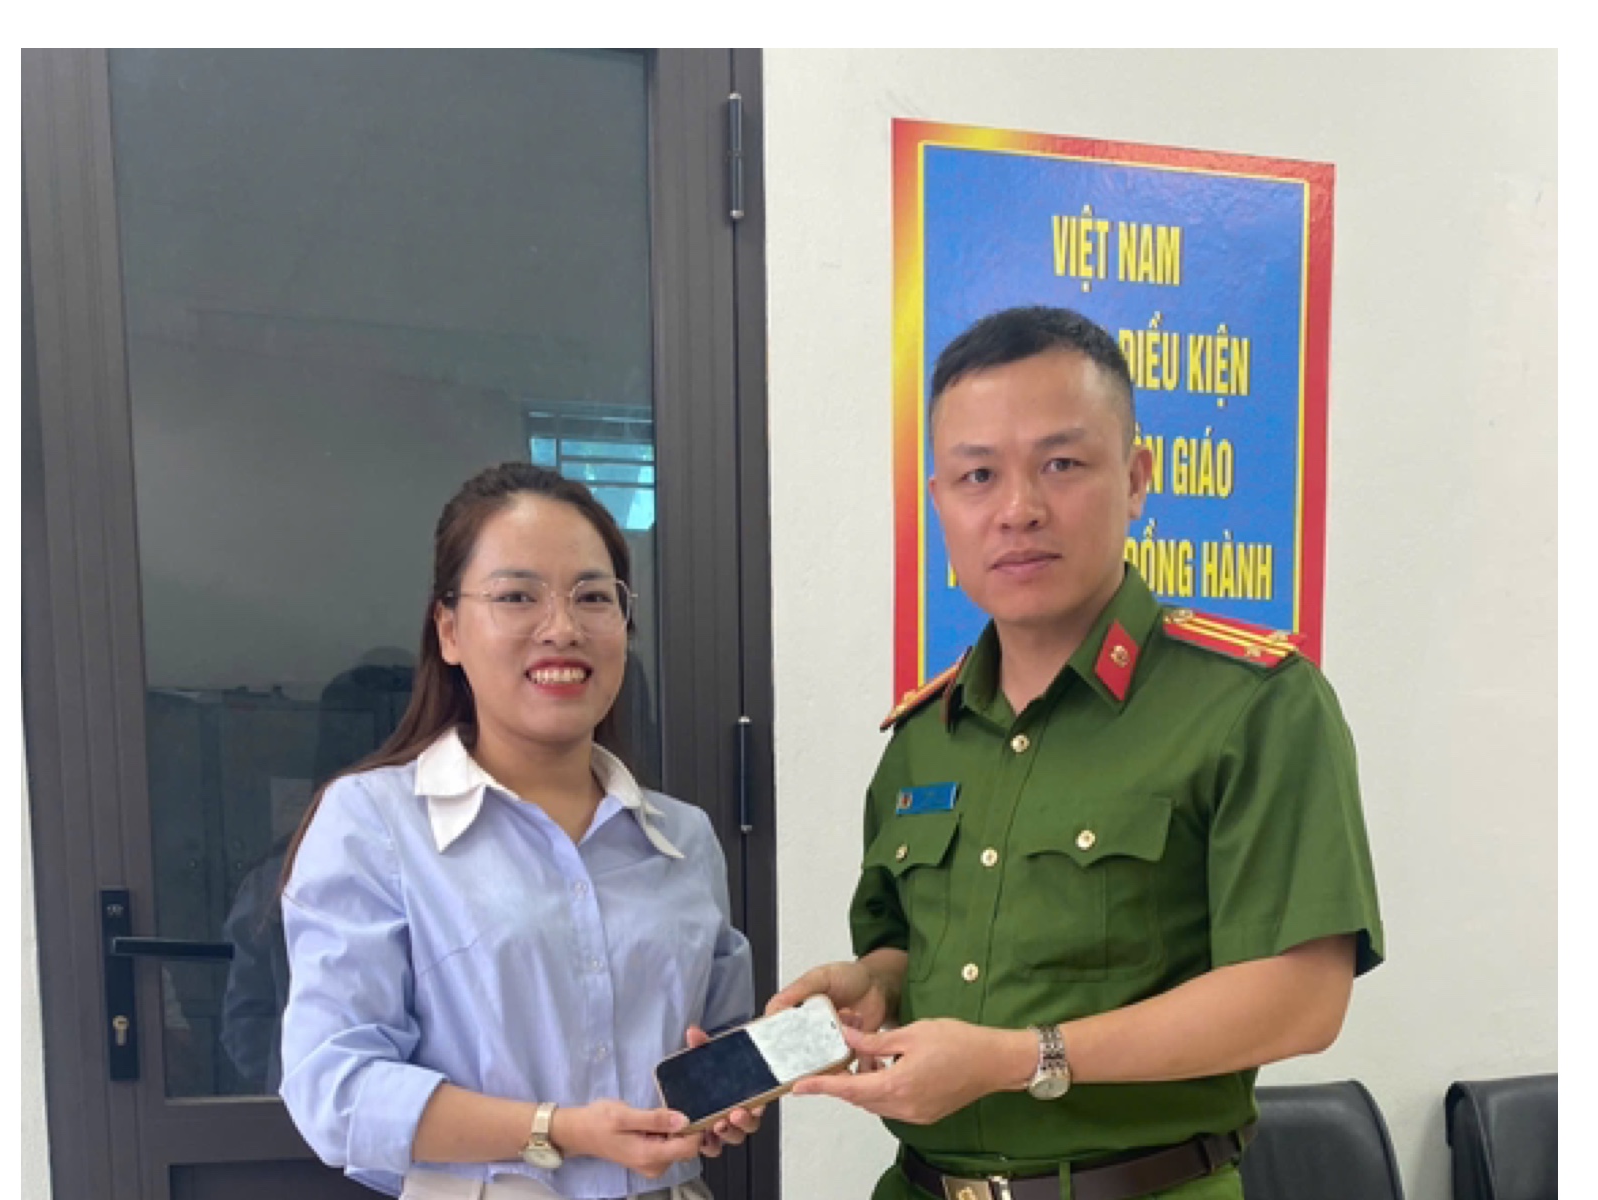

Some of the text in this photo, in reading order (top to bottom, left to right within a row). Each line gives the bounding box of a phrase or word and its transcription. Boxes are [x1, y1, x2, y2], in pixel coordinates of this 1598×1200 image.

[1051, 203, 1183, 294] VIỆT NAM
[1187, 322, 1251, 407] KIỆN
[1172, 425, 1234, 498] GIÁO
[1202, 528, 1274, 600] HÀNH
